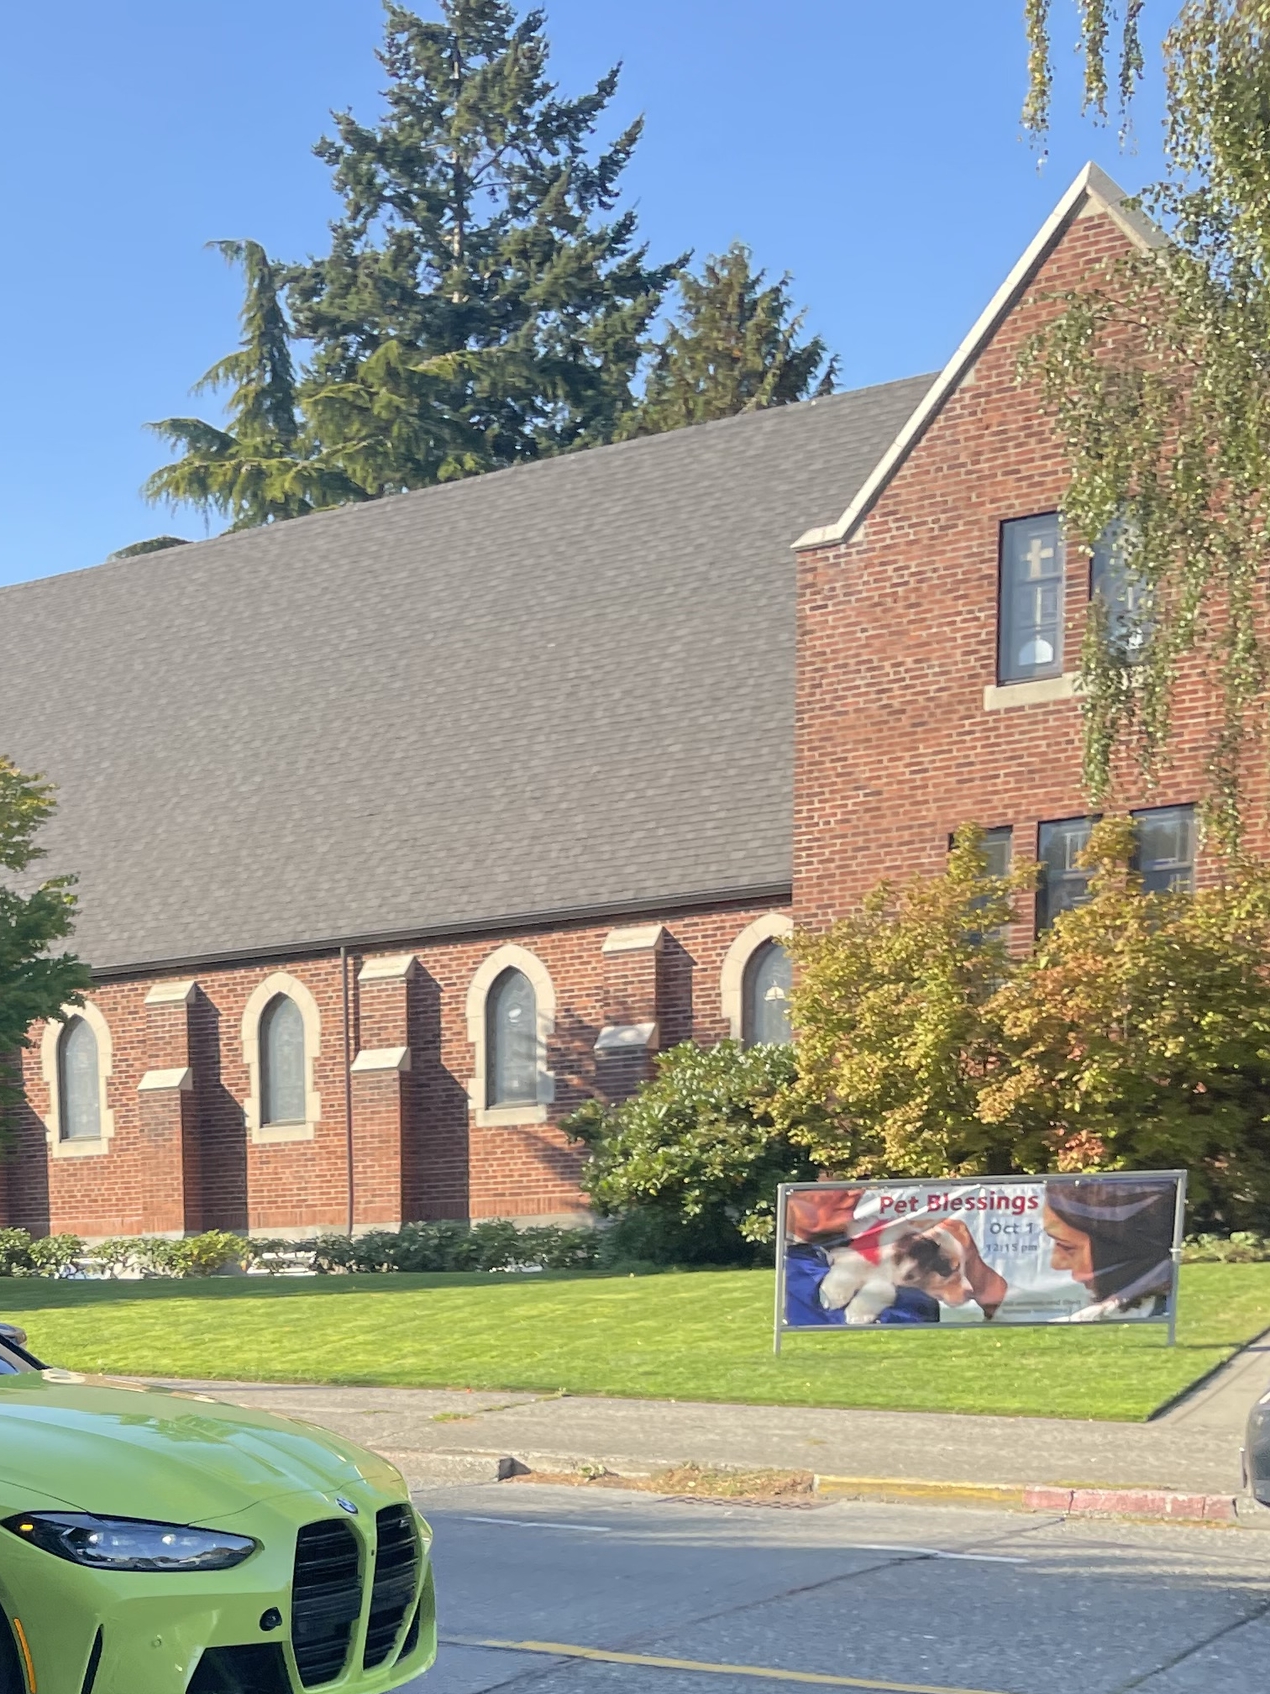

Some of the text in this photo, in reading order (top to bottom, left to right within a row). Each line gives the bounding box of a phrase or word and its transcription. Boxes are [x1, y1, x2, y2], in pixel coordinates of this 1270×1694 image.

[879, 1191, 1039, 1216] Pet Blessings
[989, 1222, 1019, 1235] Oct
[1021, 1244, 1038, 1254] pm
